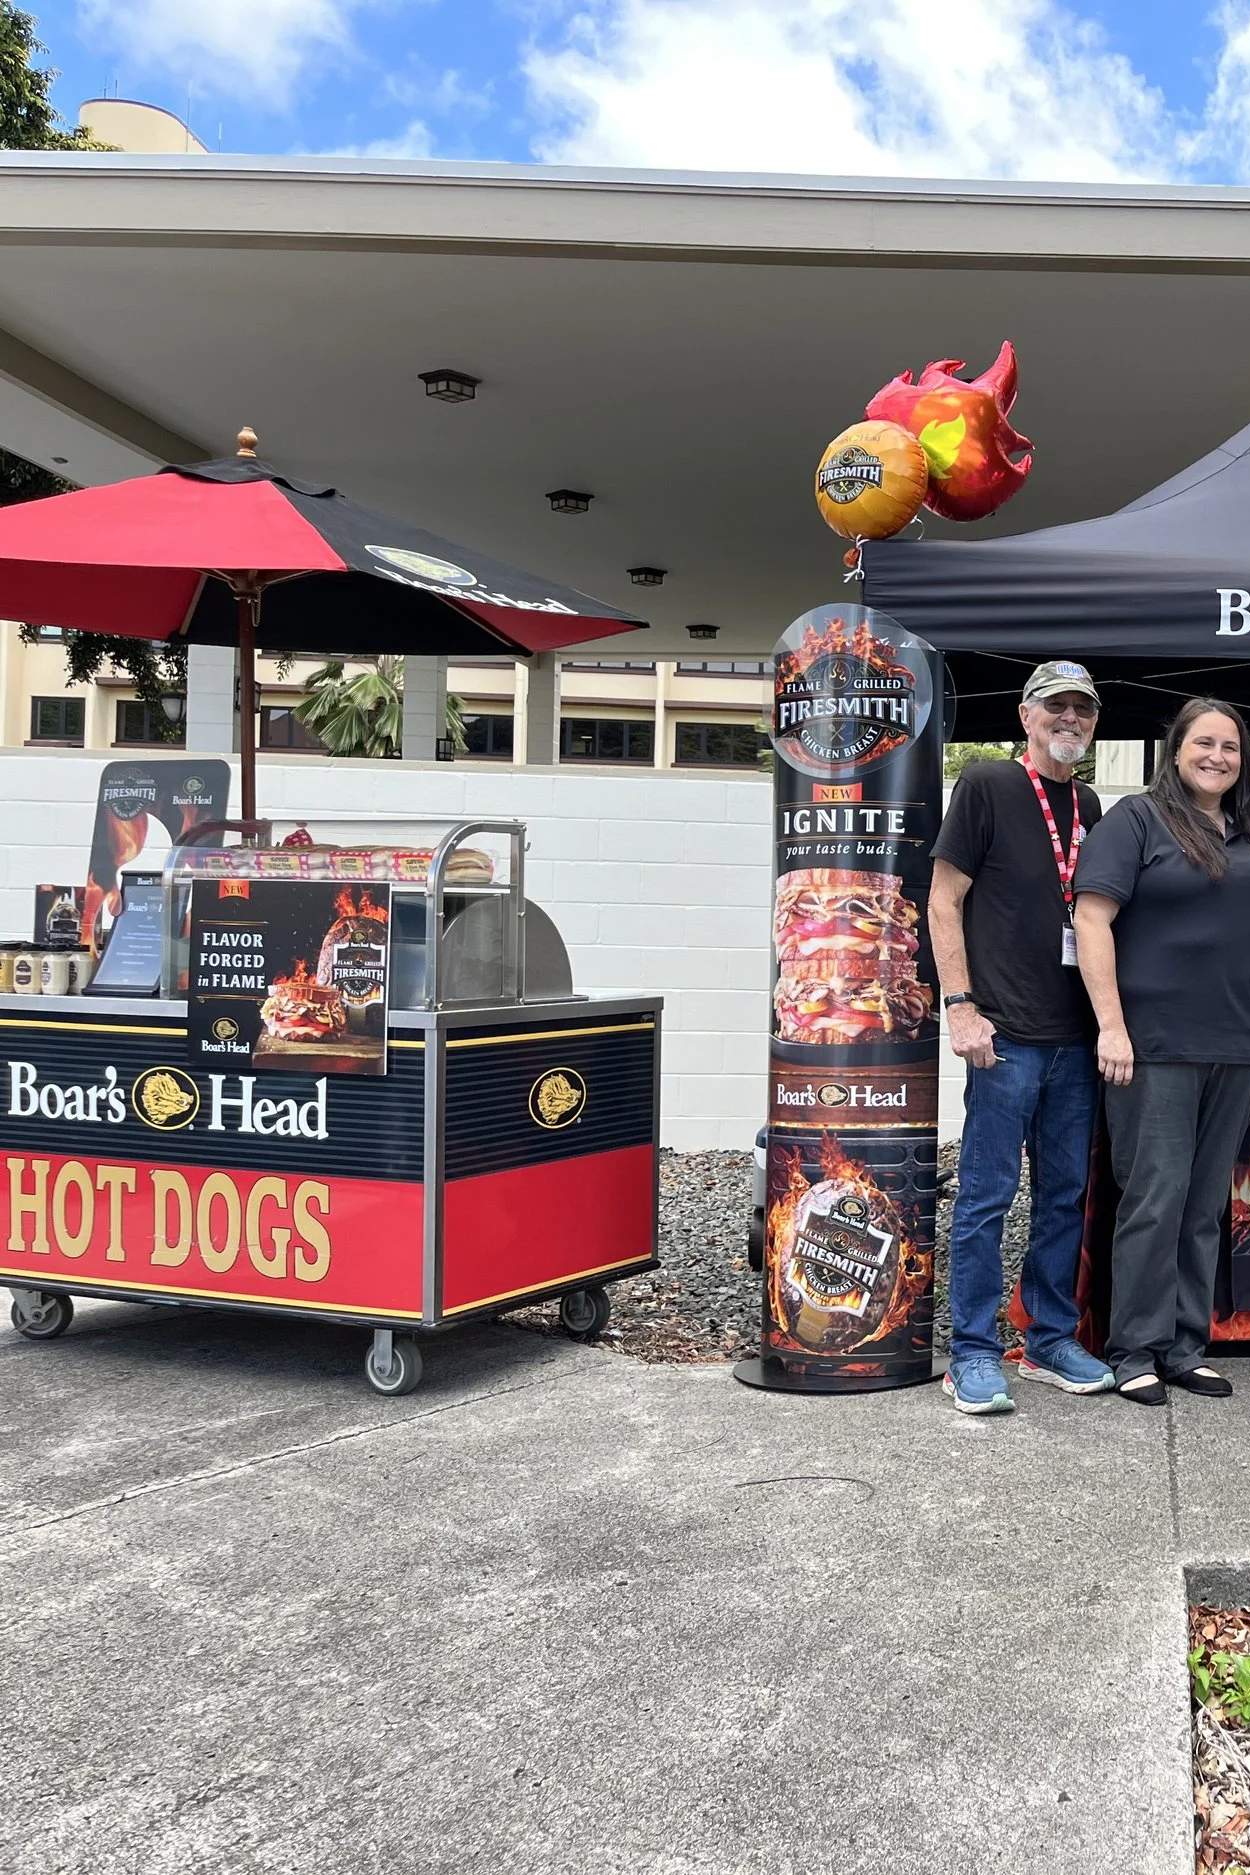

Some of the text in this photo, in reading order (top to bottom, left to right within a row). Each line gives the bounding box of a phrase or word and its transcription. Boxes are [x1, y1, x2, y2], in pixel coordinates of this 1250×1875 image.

[819, 466, 880, 487] FIRESMITH
[786, 679, 901, 694] FLAME GRILLED
[779, 697, 909, 730] FIRESMITH
[800, 726, 879, 759] CHICKEN BREAST
[103, 788, 156, 802] FIRESMITH
[172, 795, 212, 805] Boar's Head
[820, 789, 853, 800] NEW
[783, 809, 906, 835] IGNITE
[785, 845, 811, 860] your
[816, 843, 850, 855] taste
[223, 885, 245, 895] NEW
[202, 932, 264, 948] FLAVOR
[200, 953, 265, 968] FORGED
[198, 974, 266, 989] in FLAME
[333, 968, 384, 982] FIRESMITH
[201, 1040, 250, 1054] Boar's Head
[7, 1061, 329, 1140] Boar's Head
[776, 1083, 907, 1107] Boar's Head
[6, 1157, 332, 1283] HOT DOGS
[805, 1229, 877, 1263] FLAME GRILLED
[794, 1236, 879, 1288] FIRESMITH
[805, 1263, 853, 1294] CHICKEN BREAST
